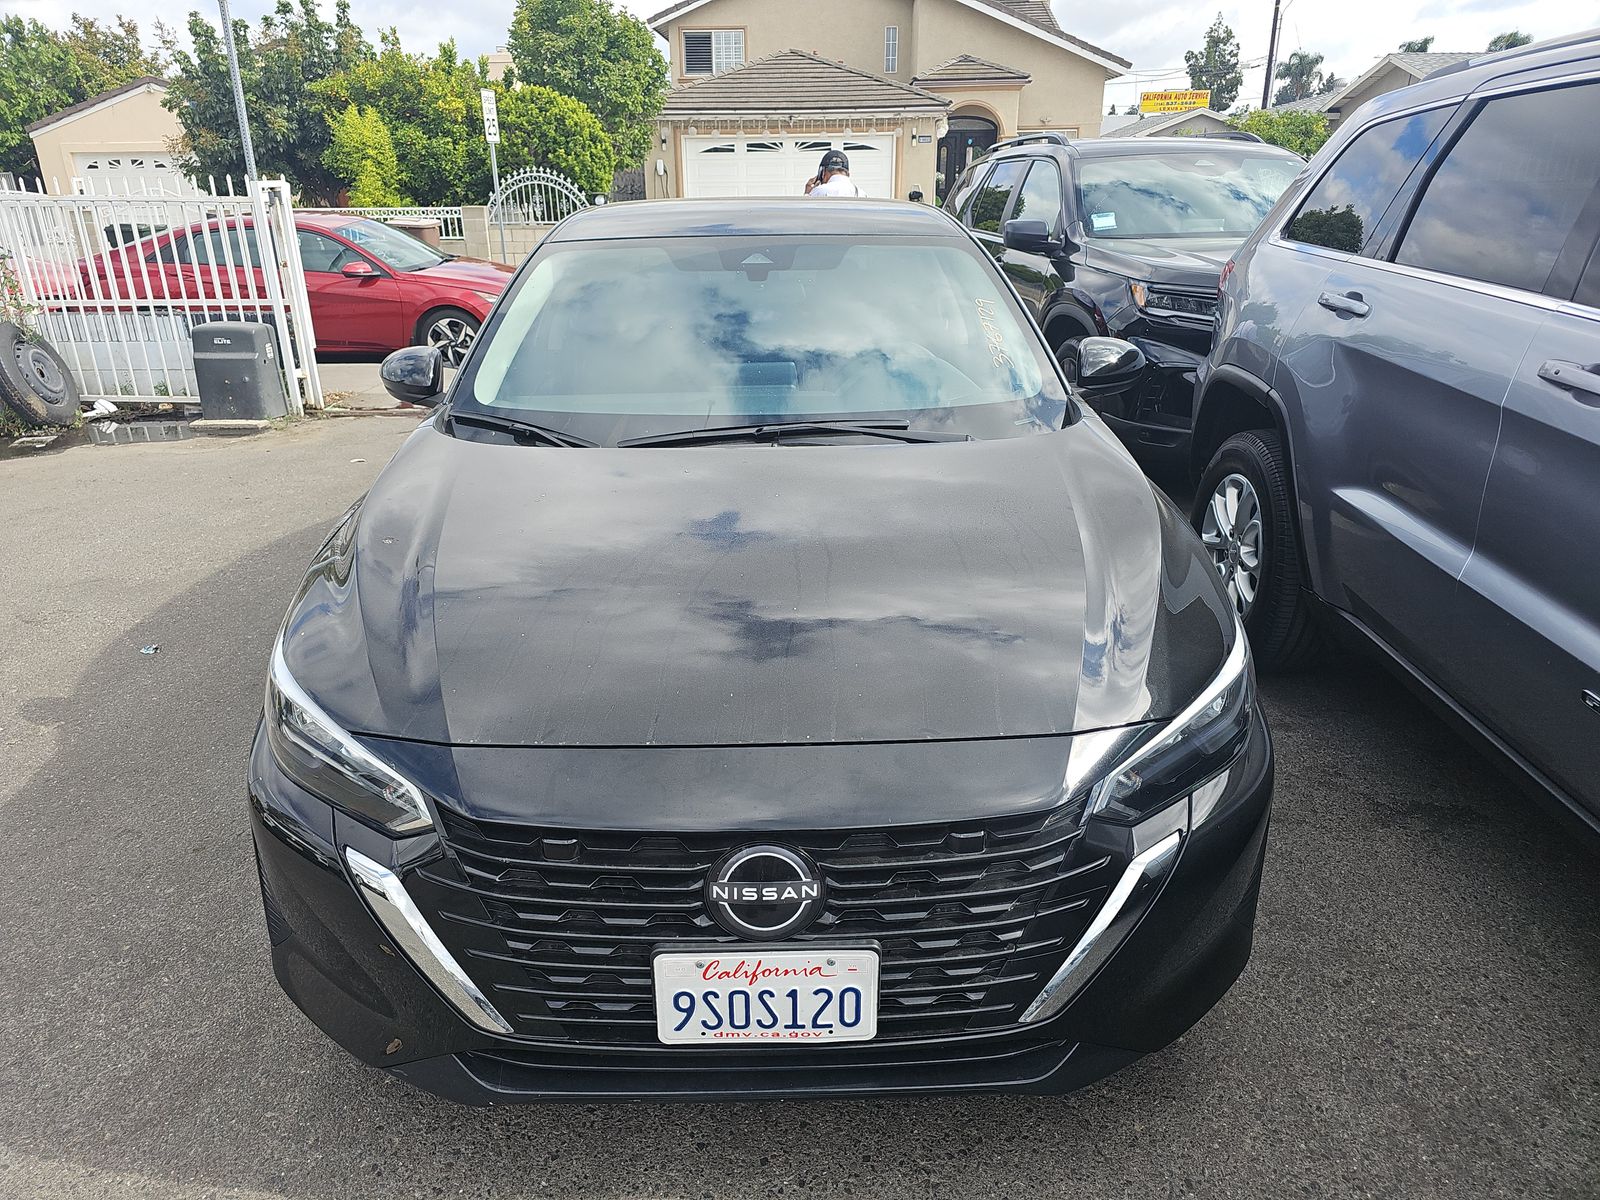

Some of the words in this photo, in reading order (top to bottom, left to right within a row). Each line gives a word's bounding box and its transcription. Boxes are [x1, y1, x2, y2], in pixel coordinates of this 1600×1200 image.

[1174, 92, 1188, 100] AUTO
[1188, 91, 1209, 100] SERVICE
[712, 883, 818, 901] NISSAN
[702, 960, 837, 986] California
[713, 1031, 823, 1039] dmv.ca.gov
